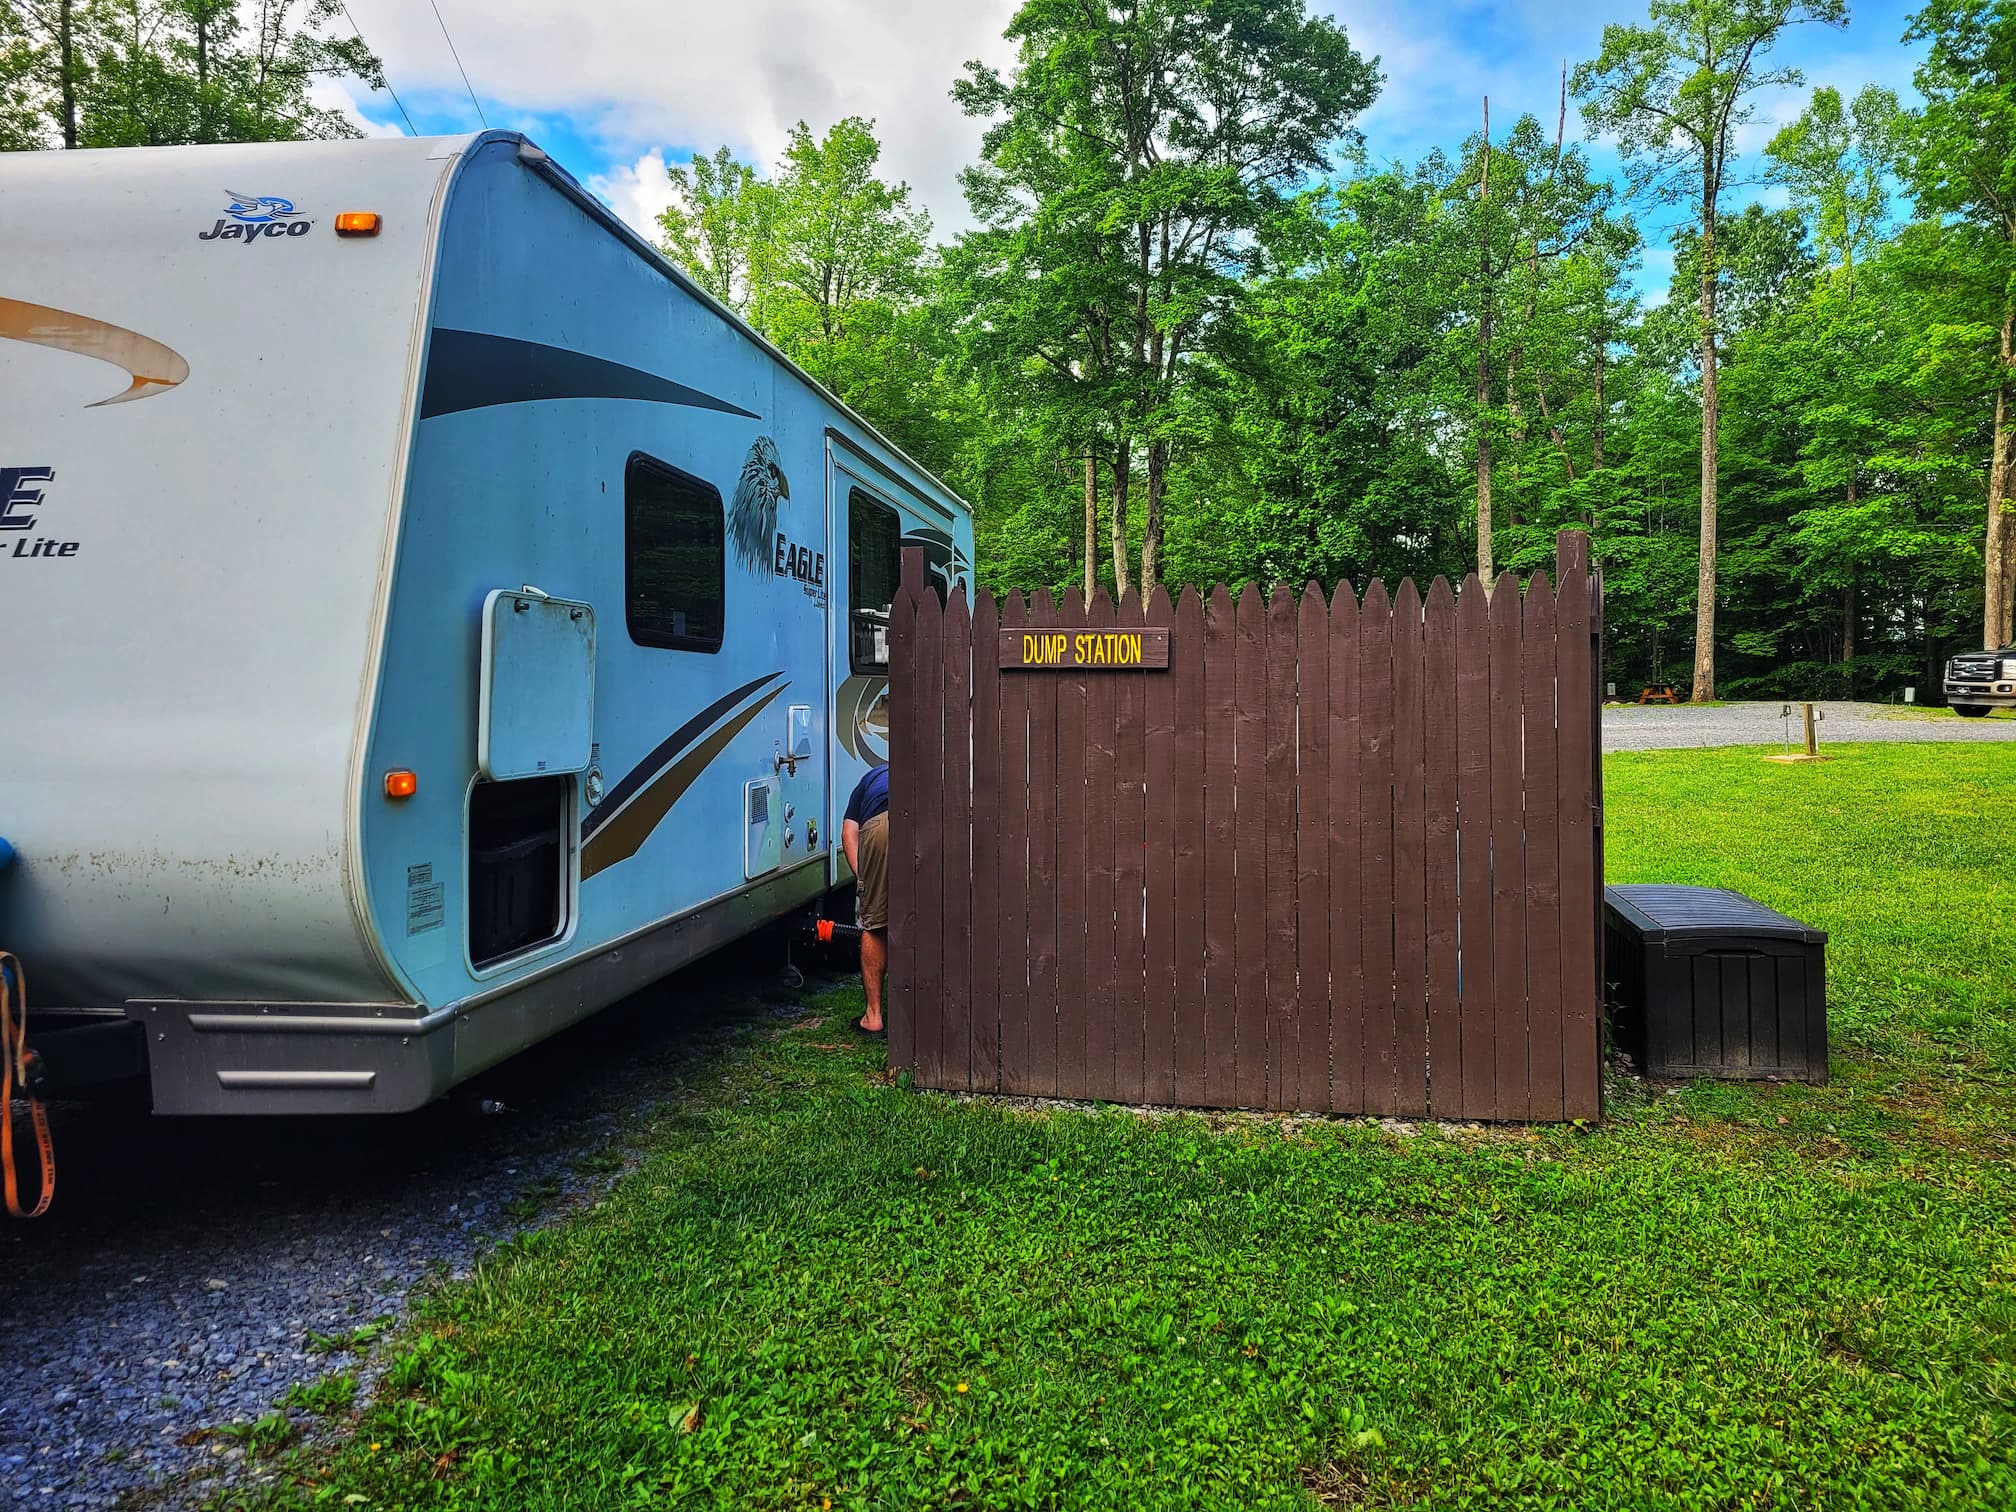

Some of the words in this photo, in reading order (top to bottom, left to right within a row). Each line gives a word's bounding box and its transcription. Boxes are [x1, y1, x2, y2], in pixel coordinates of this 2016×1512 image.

[199, 219, 311, 244] Jayco
[12, 537, 80, 558] Lite
[775, 532, 824, 587] EAGLE
[1023, 634, 1067, 664] DUMP
[1075, 634, 1142, 664] STATION
